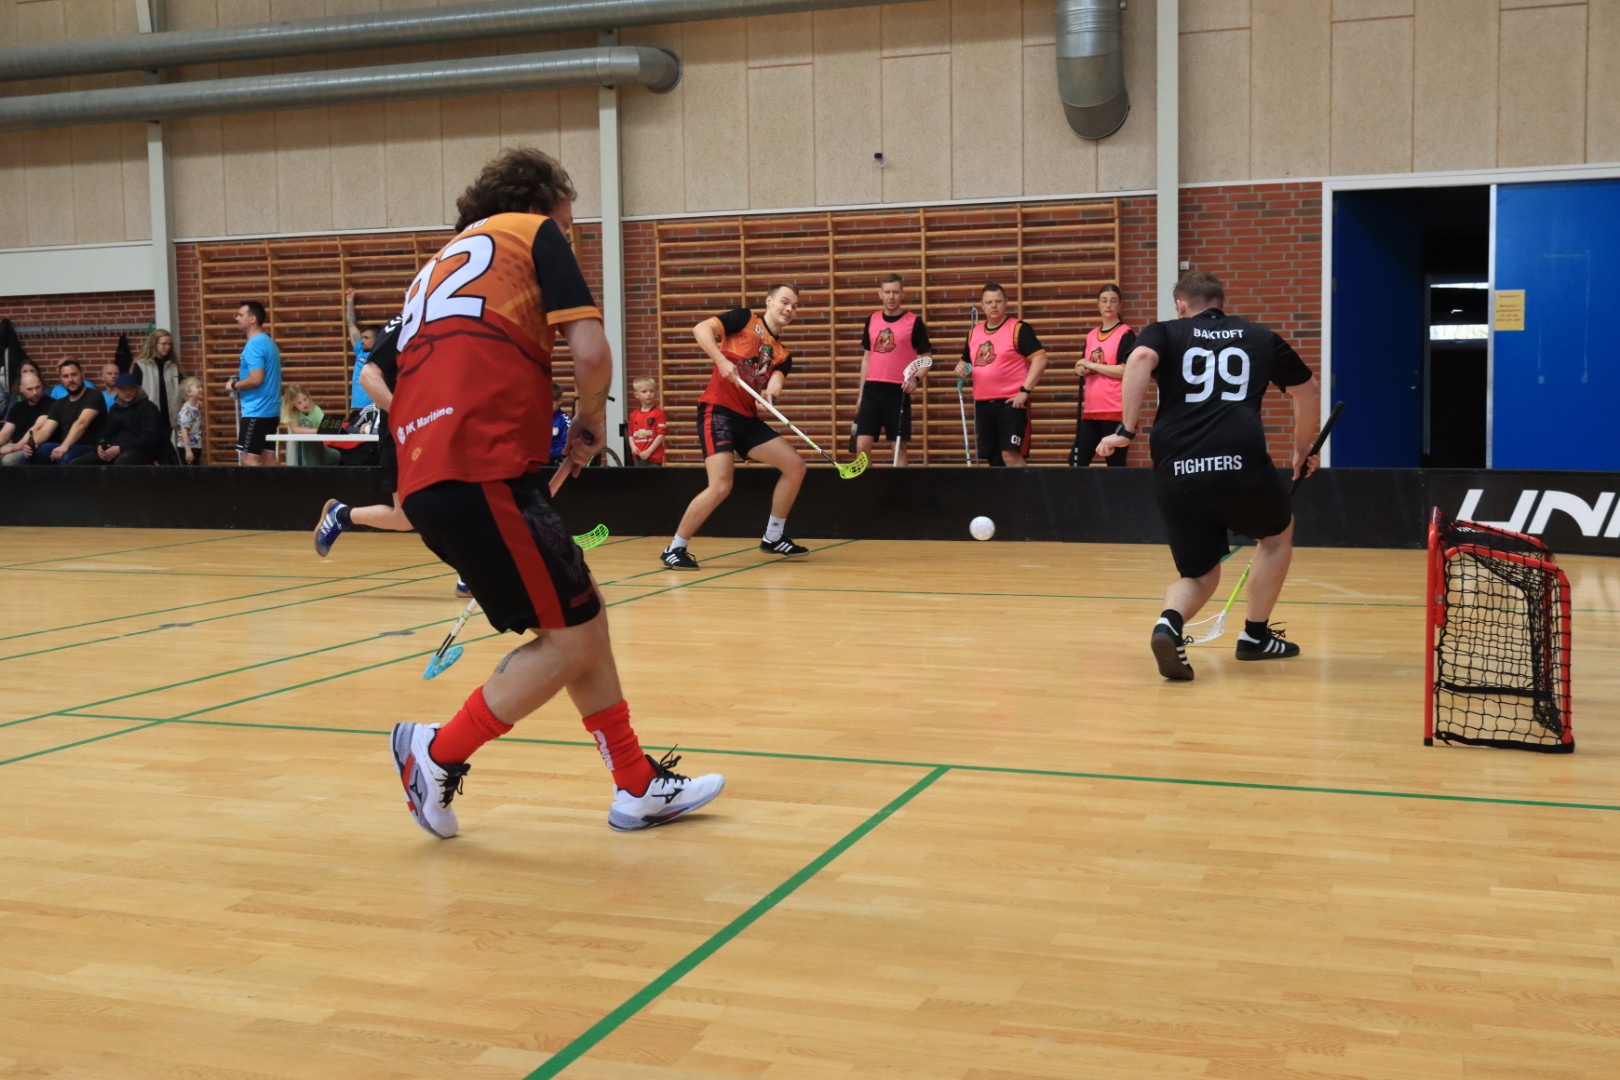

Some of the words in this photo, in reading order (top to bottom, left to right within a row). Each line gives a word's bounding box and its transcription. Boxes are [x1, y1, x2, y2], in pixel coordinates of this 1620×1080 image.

[396, 233, 496, 353] 92
[1193, 328, 1244, 340] BAKTOFT
[1182, 346, 1251, 403] 99
[416, 406, 454, 429] Maritime
[1173, 454, 1243, 477] FIGHTERS
